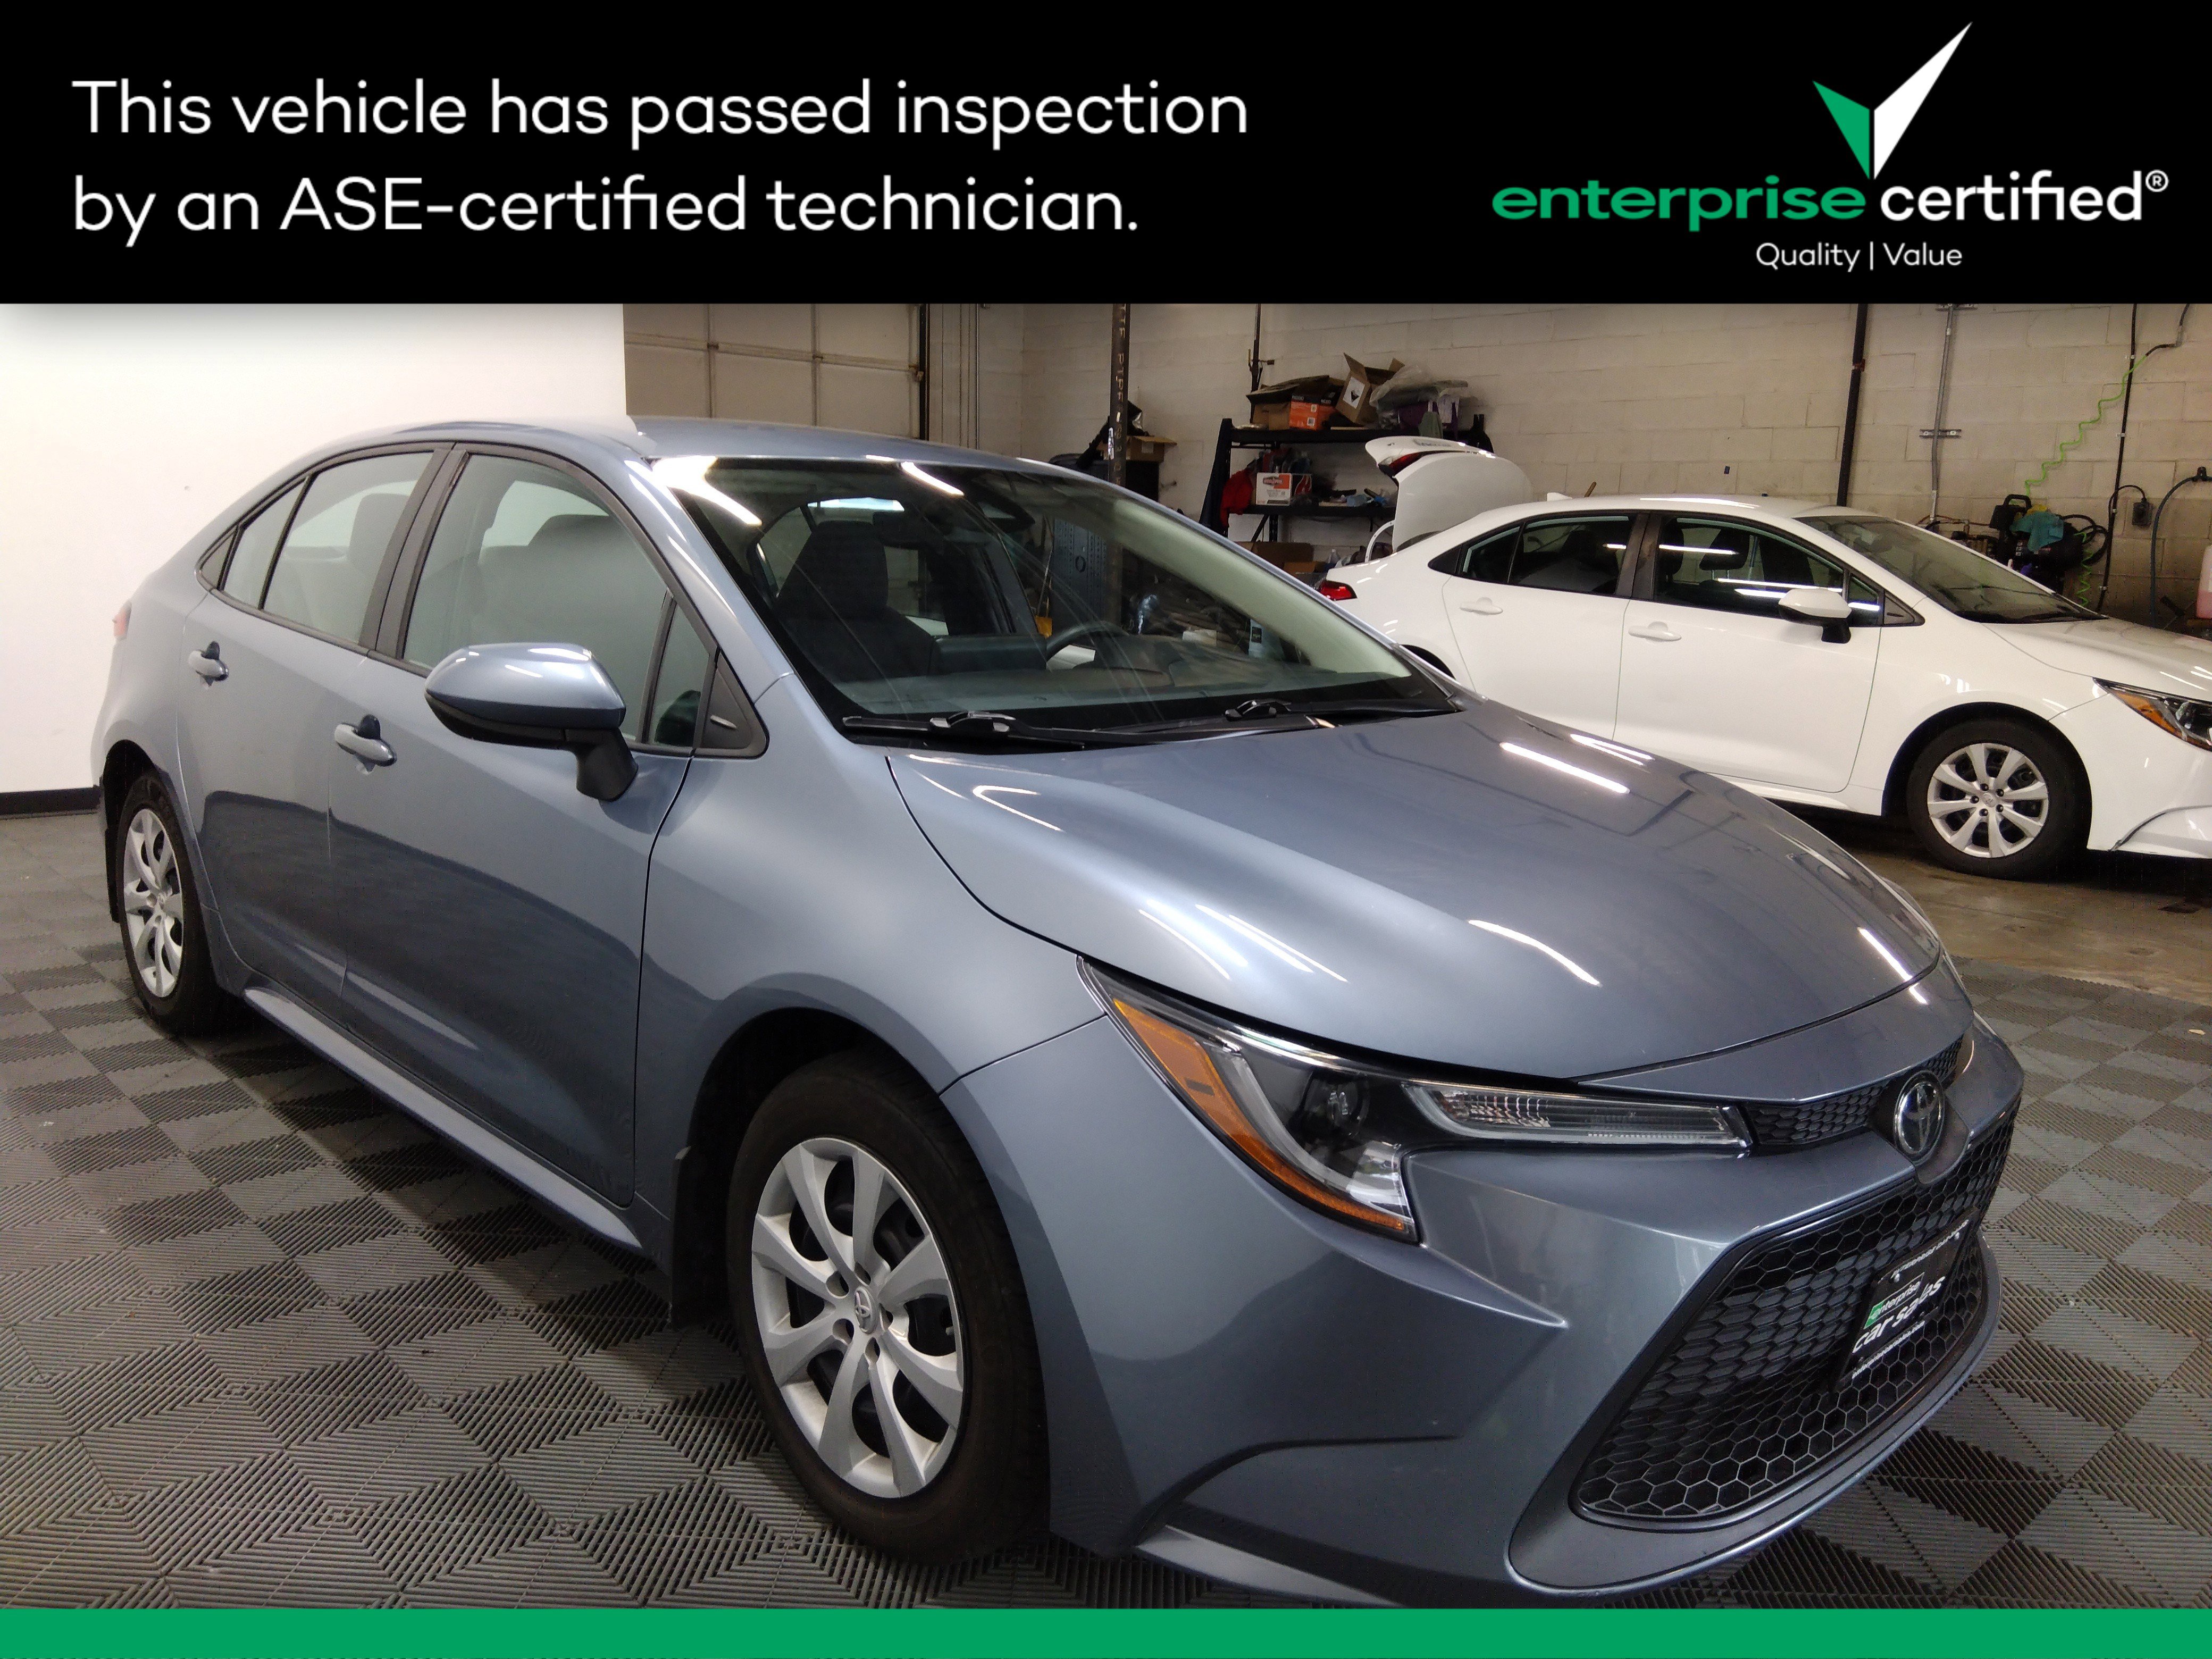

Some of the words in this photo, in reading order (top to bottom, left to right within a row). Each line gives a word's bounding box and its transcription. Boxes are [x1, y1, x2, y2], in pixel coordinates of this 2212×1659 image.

[1852, 1315, 1894, 1354] car
[1891, 1276, 1946, 1328] sales
[1870, 1281, 1921, 1320] enterprise
